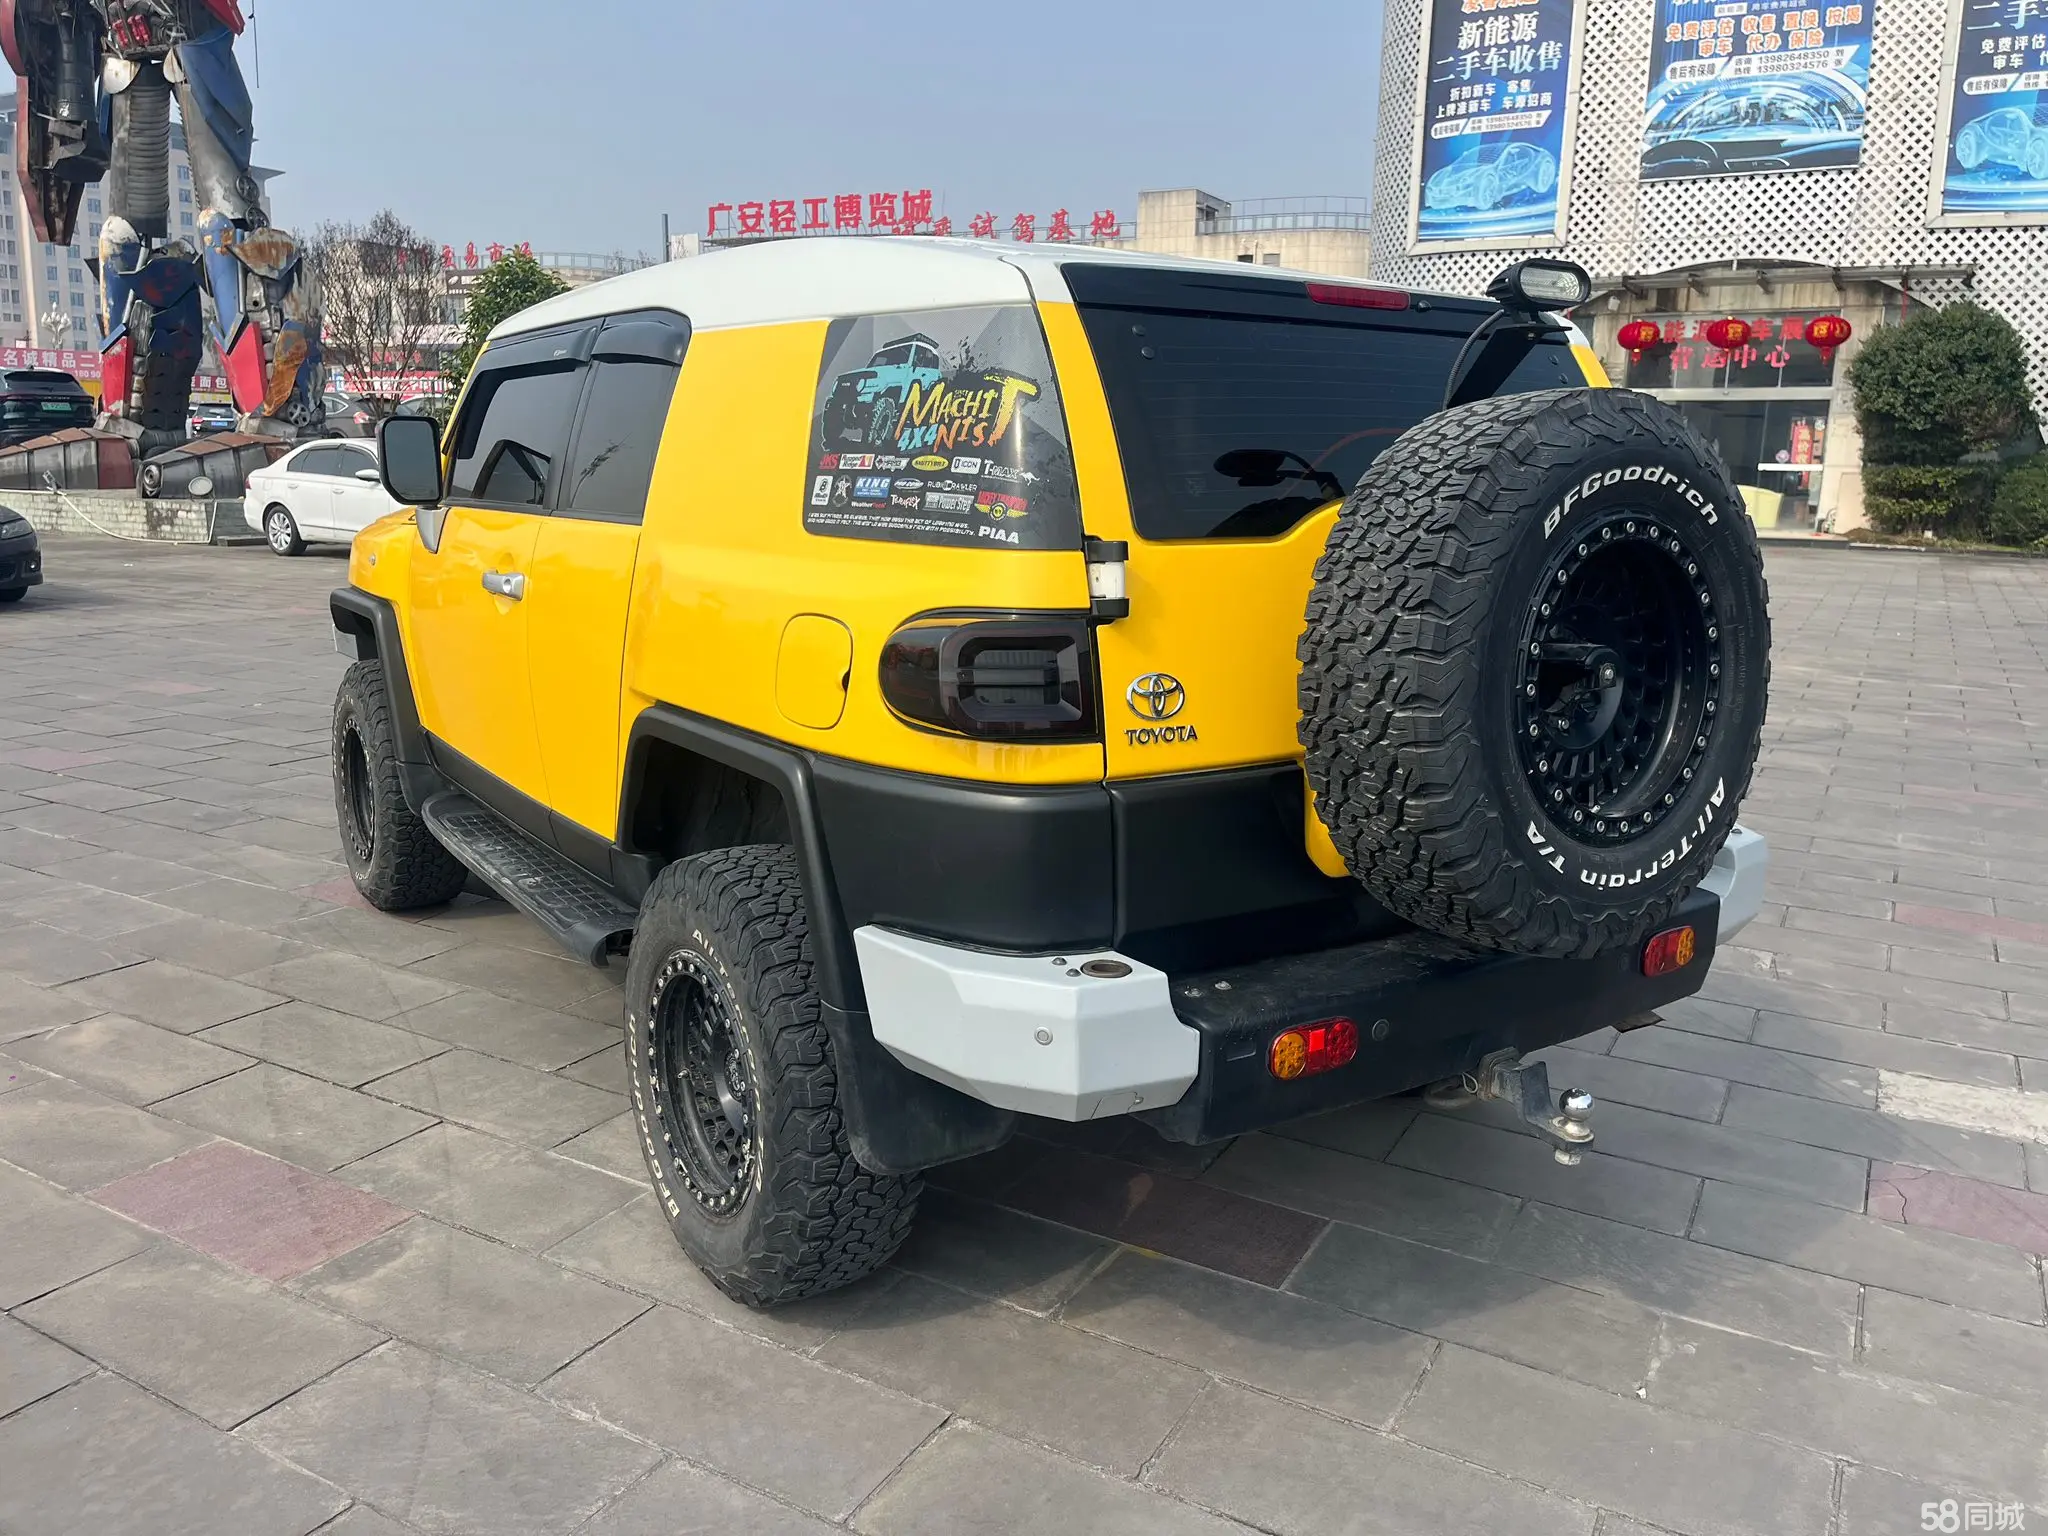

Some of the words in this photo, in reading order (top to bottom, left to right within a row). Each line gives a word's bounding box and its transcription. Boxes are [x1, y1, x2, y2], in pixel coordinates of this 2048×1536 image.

[1666, 18, 1734, 42] 免费评估
[1741, 14, 1776, 34] 收售
[1784, 9, 1818, 31] 置换
[1826, 5, 1863, 27] 按揭
[1967, 0, 2048, 30] 二手
[1457, 11, 1540, 50] 新能源
[1698, 37, 1733, 57] 审车
[1746, 33, 1782, 52] 代办
[1789, 29, 1825, 49] 保险
[1980, 34, 2047, 54] 免费评估
[1433, 40, 1563, 83] 二手车收售
[1669, 62, 1716, 80] 售后有保障
[1757, 61, 1829, 74] 13980324576
[1758, 50, 1830, 65] 13982648350
[1993, 53, 2024, 70] 审车
[707, 190, 933, 237] 广安轻工博览城
[961, 460, 978, 469] ICON
[856, 478, 891, 488] KING
[1543, 465, 1719, 540] BFGoodrich
[978, 525, 1019, 544] PIAA
[1124, 725, 1198, 746] TOYOTA
[1525, 819, 1565, 875] T/A
[1580, 776, 1726, 891] All-Terrain
[628, 1013, 681, 1218] BFGoodrich
